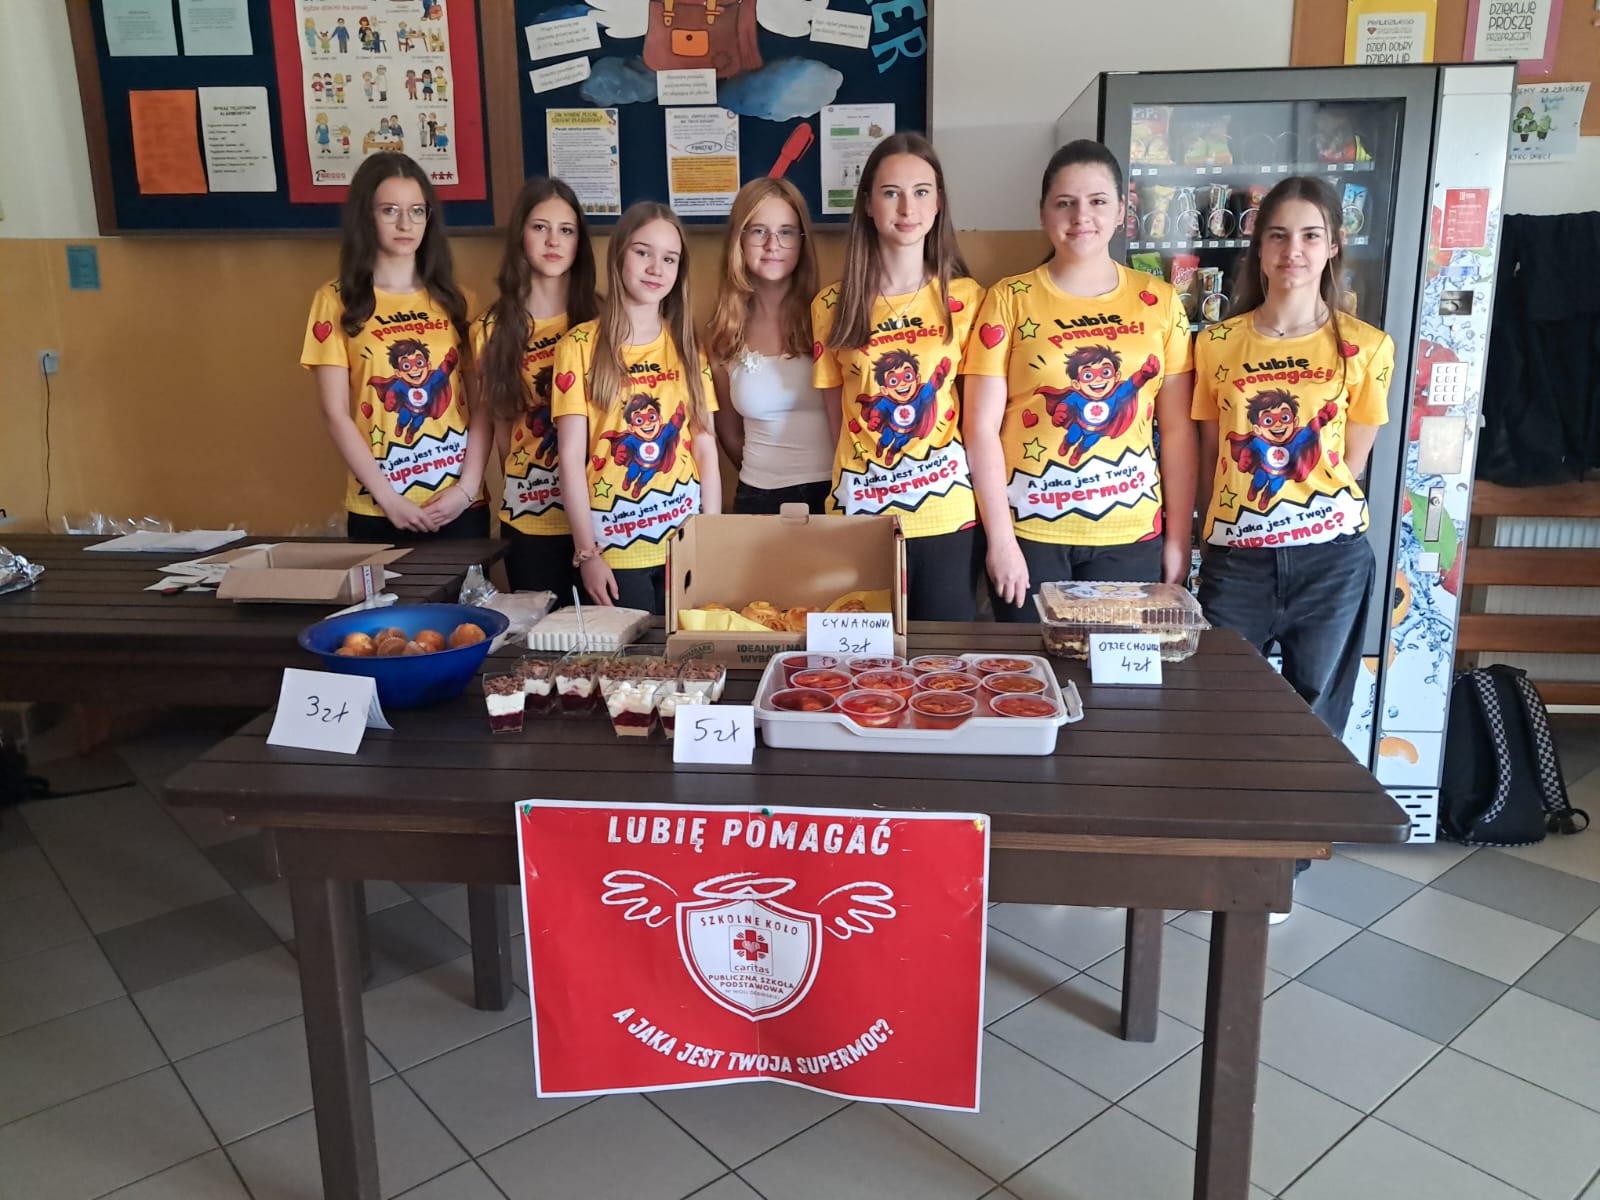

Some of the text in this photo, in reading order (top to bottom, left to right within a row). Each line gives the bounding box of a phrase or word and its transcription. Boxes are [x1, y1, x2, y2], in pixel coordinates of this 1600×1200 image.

[1488, 15, 1534, 31] PROSZĘ
[865, 0, 928, 74] ER
[375, 310, 429, 325] Lubię
[1054, 313, 1123, 330] Lubię
[371, 319, 449, 341] pomagać!
[1048, 321, 1145, 349] pomagać!
[1242, 356, 1310, 373] Lubię
[1232, 367, 1333, 393] pomagać!
[385, 448, 467, 484] upermoc?
[388, 456, 410, 471] jaka
[412, 449, 432, 463] jest
[853, 455, 949, 487] A jaka jest Twoja
[517, 481, 524, 489] A
[527, 478, 549, 490] jaka
[854, 460, 958, 504] supermoc?
[1028, 465, 1138, 491] A jaka jest Twoja
[1028, 471, 1146, 510] supermoc?
[602, 514, 610, 522] A
[612, 511, 636, 523] jaka
[638, 503, 659, 517] jest
[604, 497, 693, 538] supermoc?
[1226, 506, 1333, 537] A jaka jest Twoja
[1228, 512, 1345, 548] supermoc?
[822, 617, 890, 629] CYNAMONKI
[607, 815, 891, 856] LUBIĘ POMAGAĆ
[700, 914, 798, 936] SZKOLNE KOŁO
[734, 963, 770, 974] caritas
[708, 974, 794, 989] PUBLICZNA SZKOŁA
[720, 981, 784, 994] PODSTAWOWA
[612, 1007, 895, 1075] A JAKA JEST TWOJA SUPERMOC?
